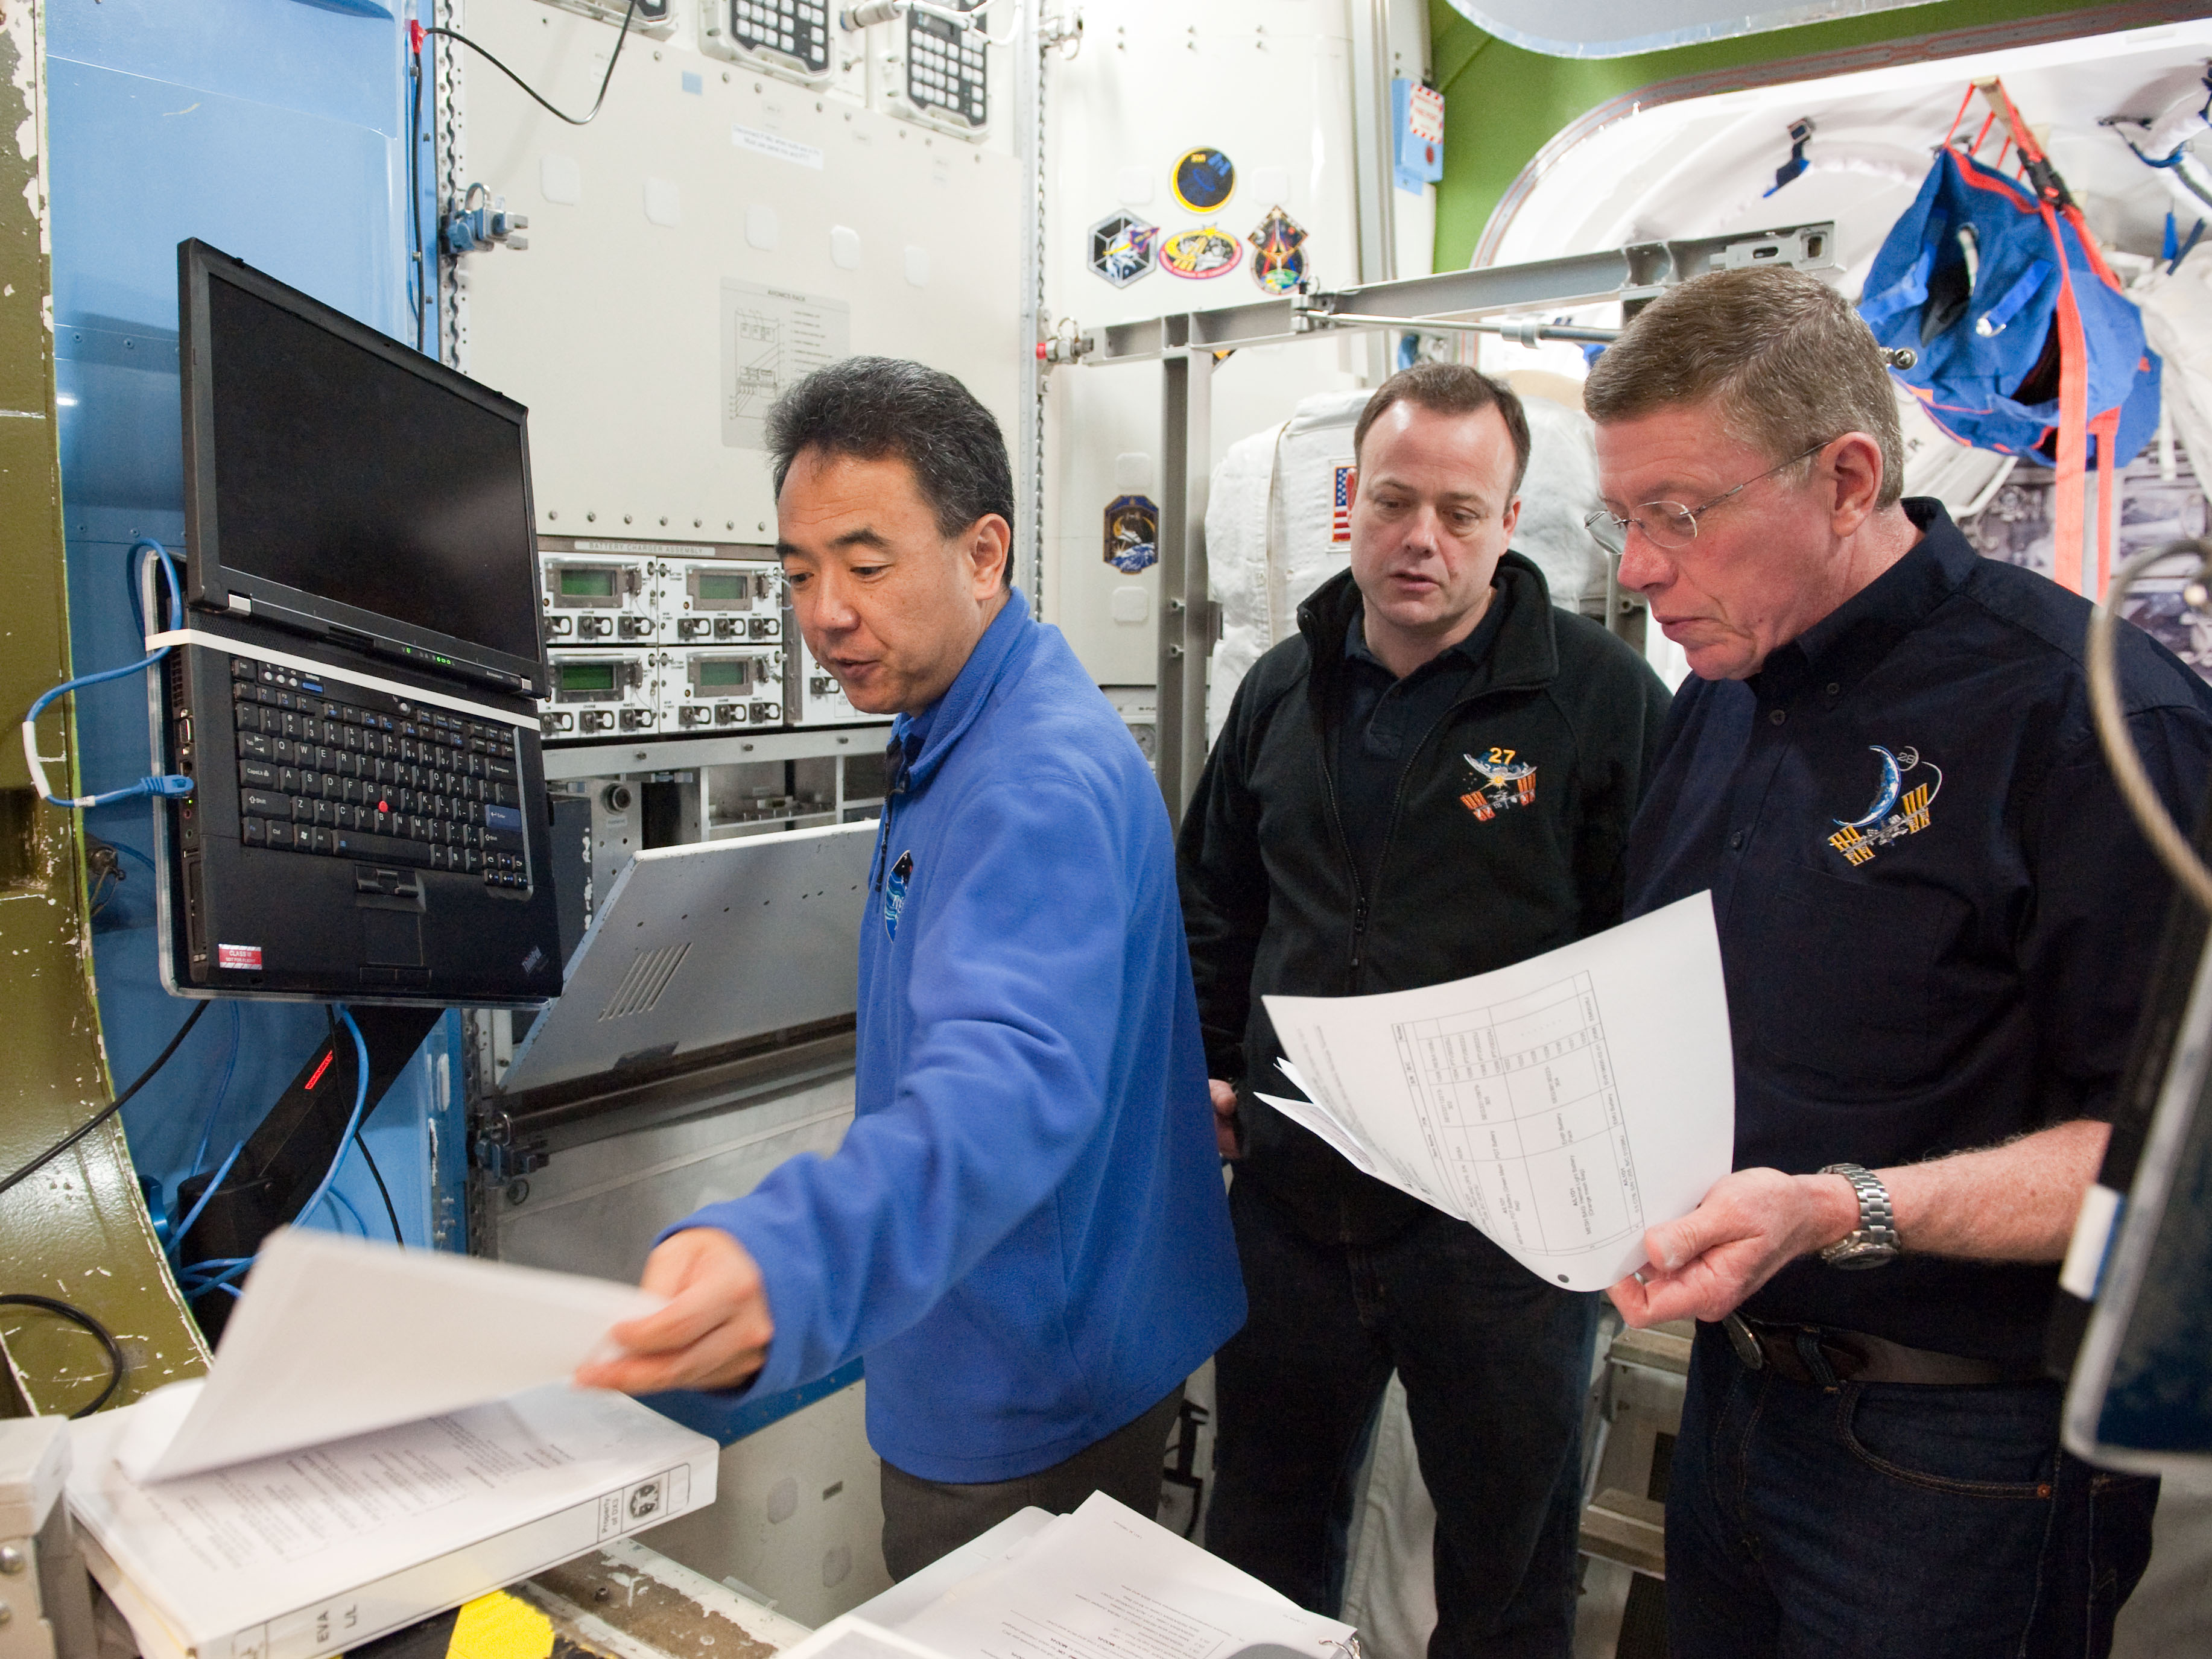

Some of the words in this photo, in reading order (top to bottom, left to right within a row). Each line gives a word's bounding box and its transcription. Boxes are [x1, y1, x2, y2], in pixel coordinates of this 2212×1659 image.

[589, 542, 626, 551] BATTERY
[626, 544, 664, 553] CHARGER
[665, 546, 703, 555] ASSEMBLY
[279, 741, 285, 750] Q
[321, 749, 326, 757] E
[1489, 747, 1516, 765] 27
[1897, 752, 1916, 764] 28
[307, 774, 312, 782] S
[328, 777, 334, 786] D
[298, 800, 303, 808] Z
[379, 812, 384, 821] B
[601, 1499, 610, 1534] Property
[344, 1605, 357, 1628] L/L
[317, 1611, 329, 1643] EVA
